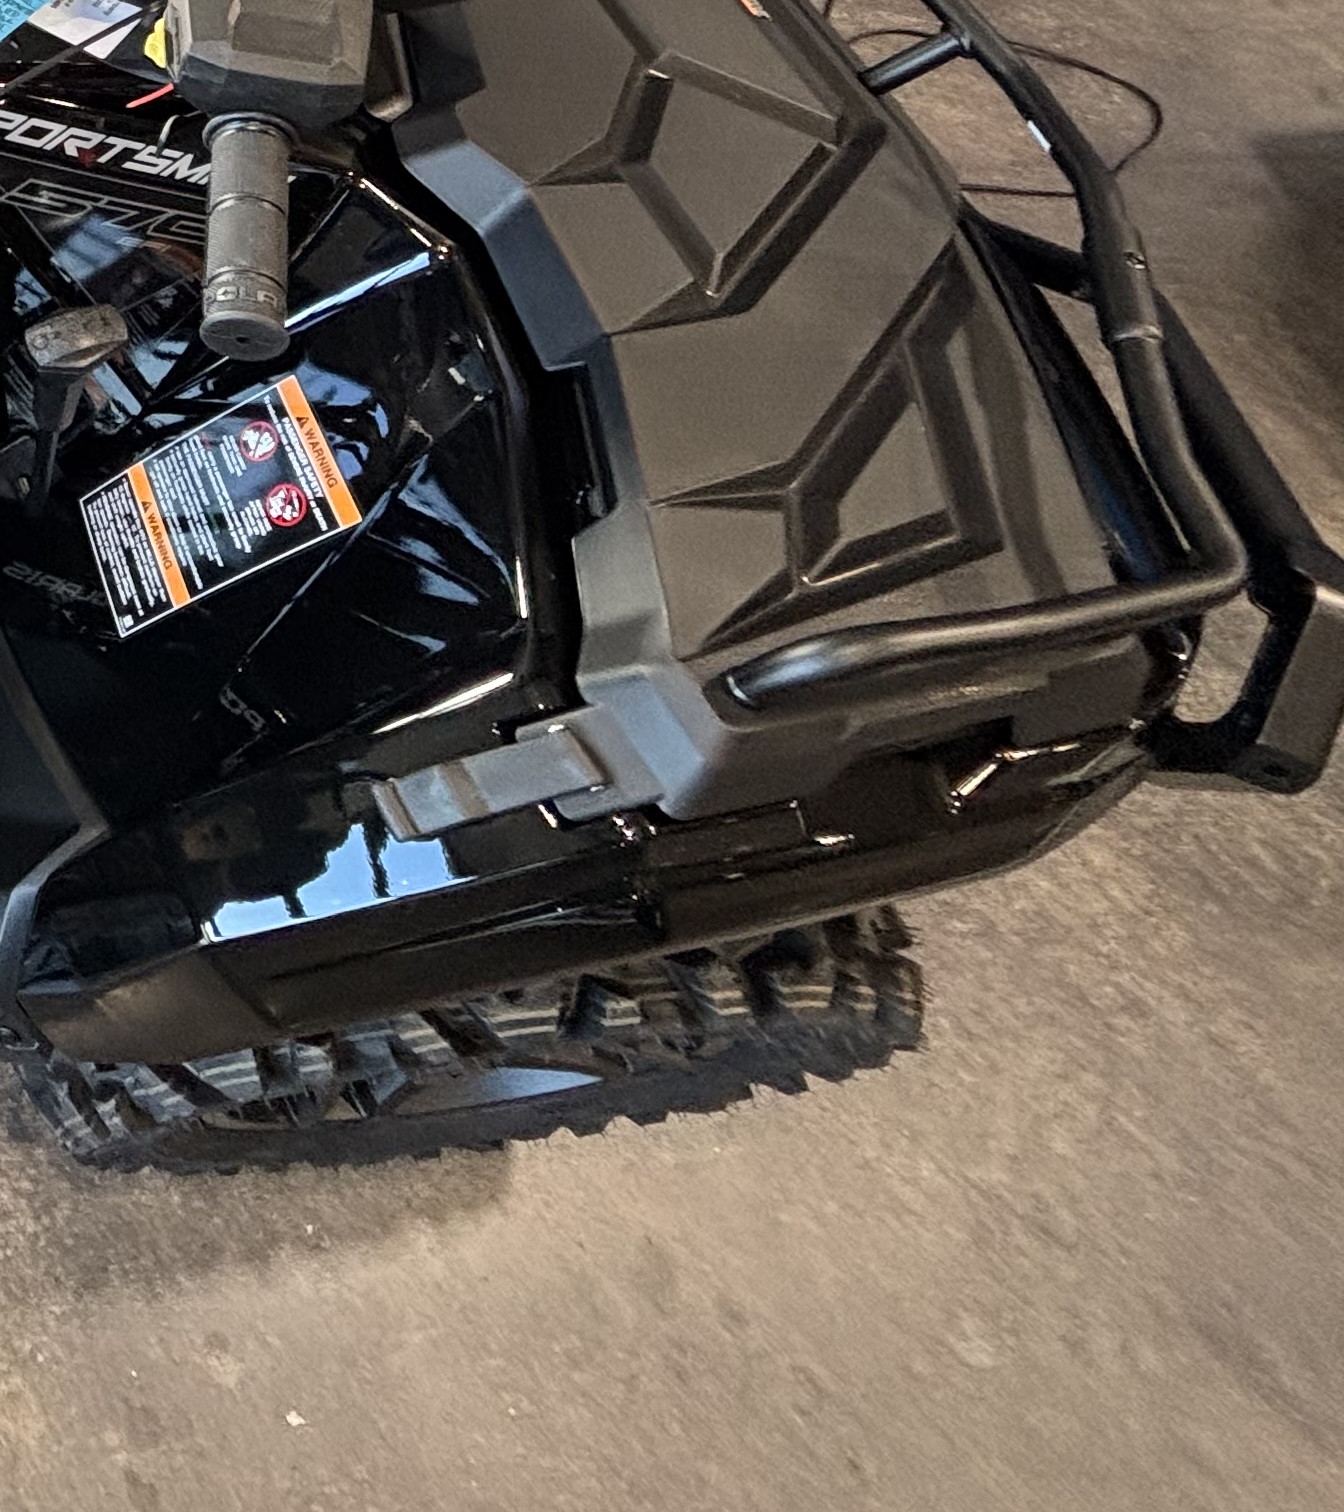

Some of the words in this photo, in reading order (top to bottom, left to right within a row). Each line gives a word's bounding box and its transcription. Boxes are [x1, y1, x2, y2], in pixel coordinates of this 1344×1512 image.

[280, 416, 309, 466] PASSENGER
[302, 464, 324, 500] SAFETY
[302, 427, 339, 489] WARNING
[145, 511, 173, 571] WARNING
